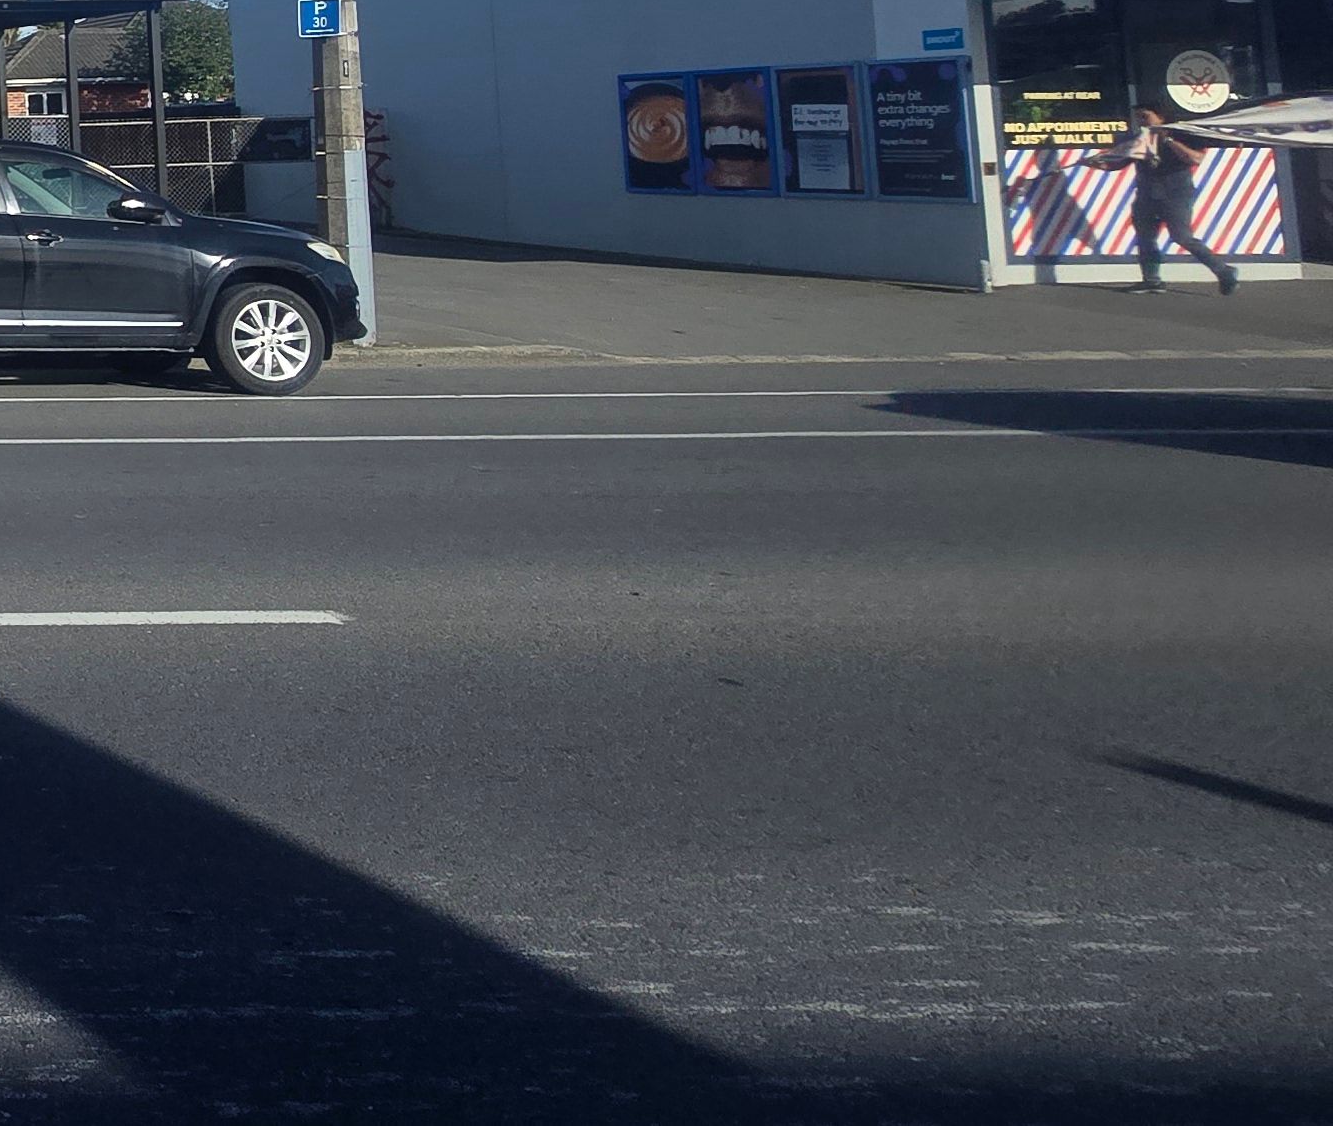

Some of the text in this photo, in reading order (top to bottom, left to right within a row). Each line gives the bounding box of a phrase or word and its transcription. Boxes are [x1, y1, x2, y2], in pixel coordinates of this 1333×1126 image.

[314, 1, 327, 15] P
[313, 17, 327, 27] 30
[877, 90, 922, 103] A tiny bit
[877, 104, 951, 116] extra changes
[878, 117, 934, 129] everything
[1052, 134, 1095, 144] WALK
